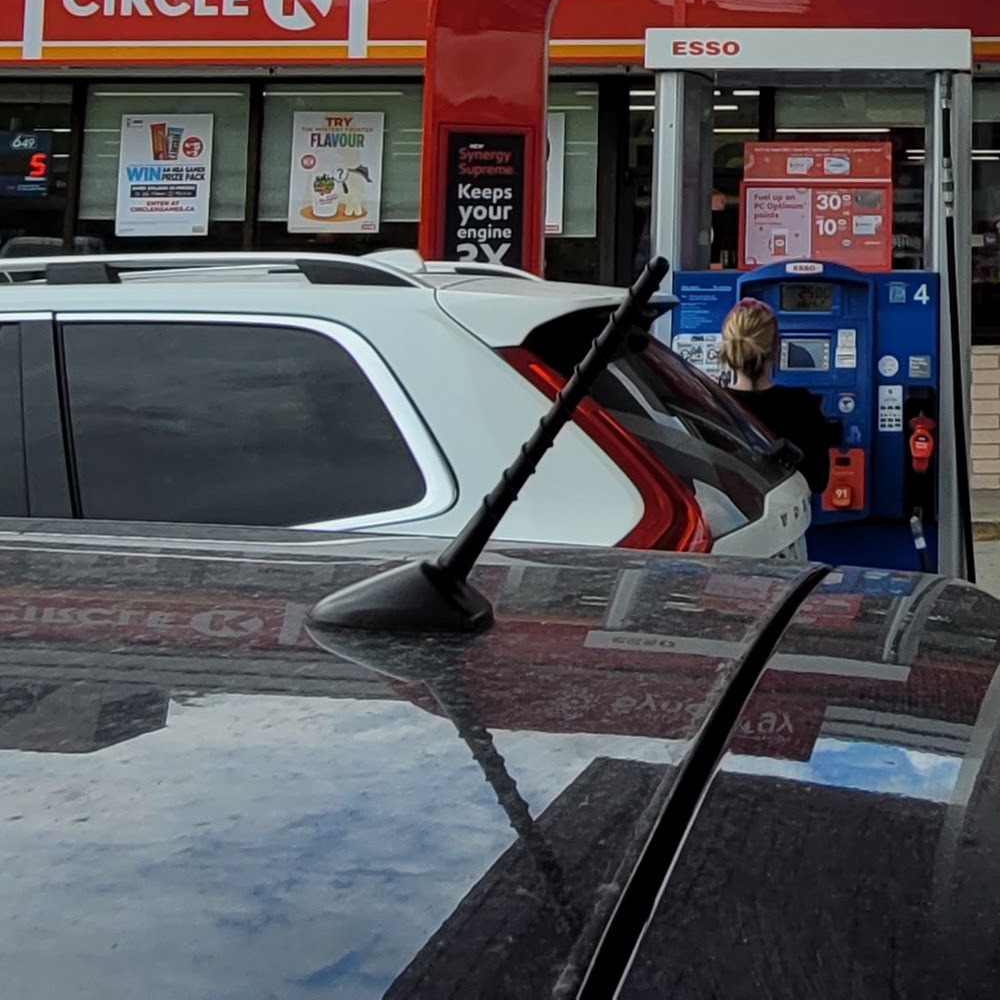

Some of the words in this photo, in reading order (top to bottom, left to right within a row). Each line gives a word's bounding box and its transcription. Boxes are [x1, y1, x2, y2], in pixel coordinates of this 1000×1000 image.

[672, 41, 740, 56] ESSO
[325, 117, 353, 127] TRY
[310, 133, 365, 148] FLAVOUR
[458, 148, 512, 163] Synergy
[126, 166, 162, 182] WIN
[161, 173, 184, 181] PRIZE
[185, 173, 206, 181] PACK
[458, 163, 514, 178] Supreme
[458, 183, 513, 204] Keeps
[773, 194, 783, 203] up
[754, 202, 766, 210] PC
[816, 194, 842, 210] 30
[458, 205, 513, 226] your
[754, 211, 780, 220] points
[457, 223, 512, 243] engine
[816, 218, 837, 236] 10
[913, 283, 930, 305] 4
[835, 489, 848, 499] 91
